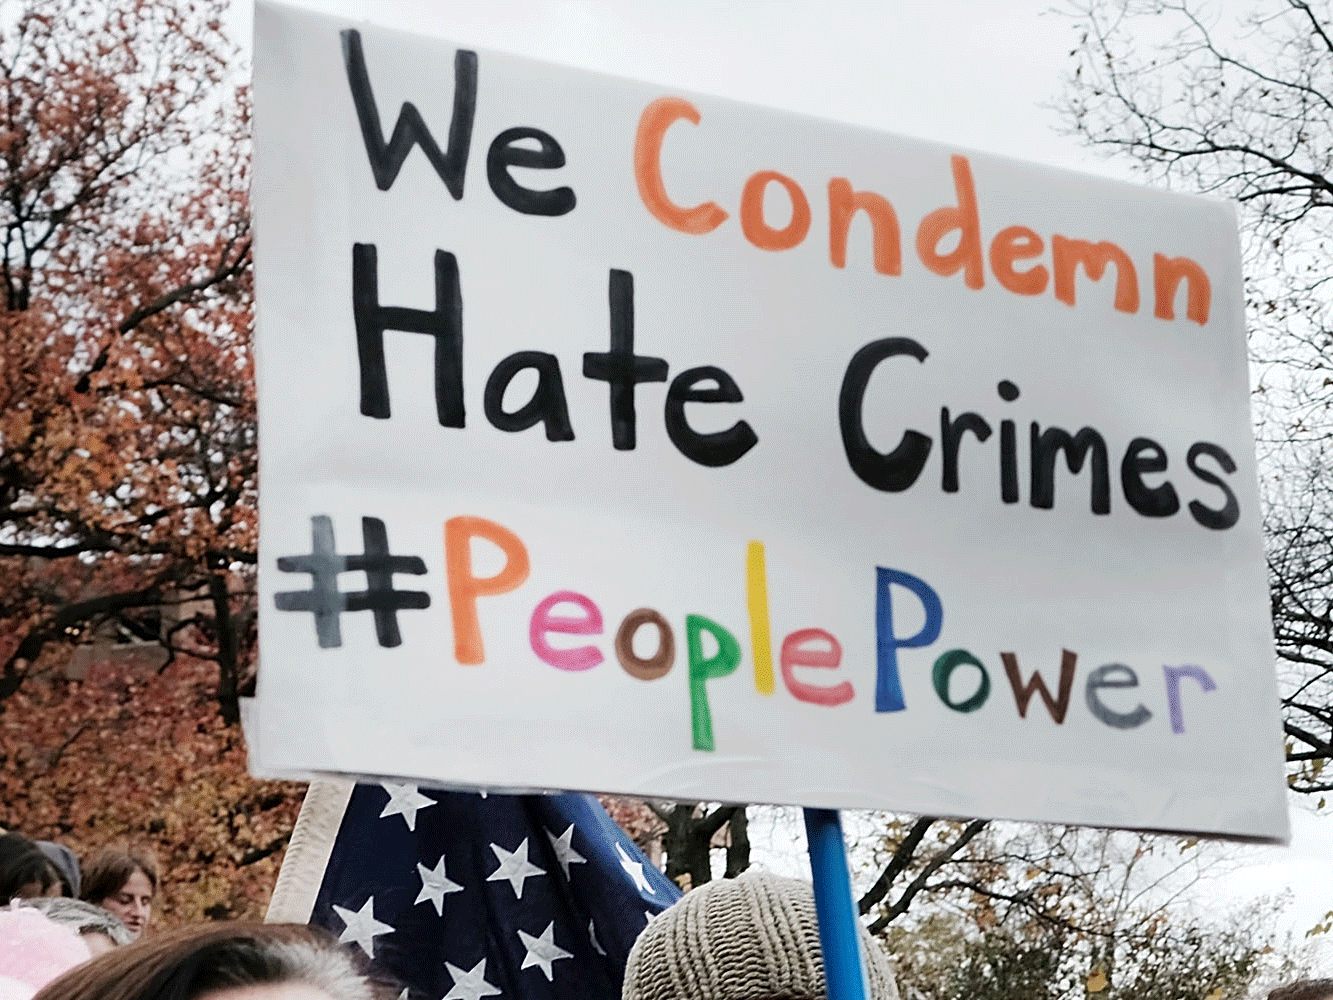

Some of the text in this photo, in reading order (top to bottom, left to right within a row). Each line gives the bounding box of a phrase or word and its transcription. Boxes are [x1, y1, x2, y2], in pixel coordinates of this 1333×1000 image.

[340, 29, 1213, 326] We Condemn
[352, 242, 1240, 531] Hate Crimes
[273, 514, 1218, 752] #PeoplePower
